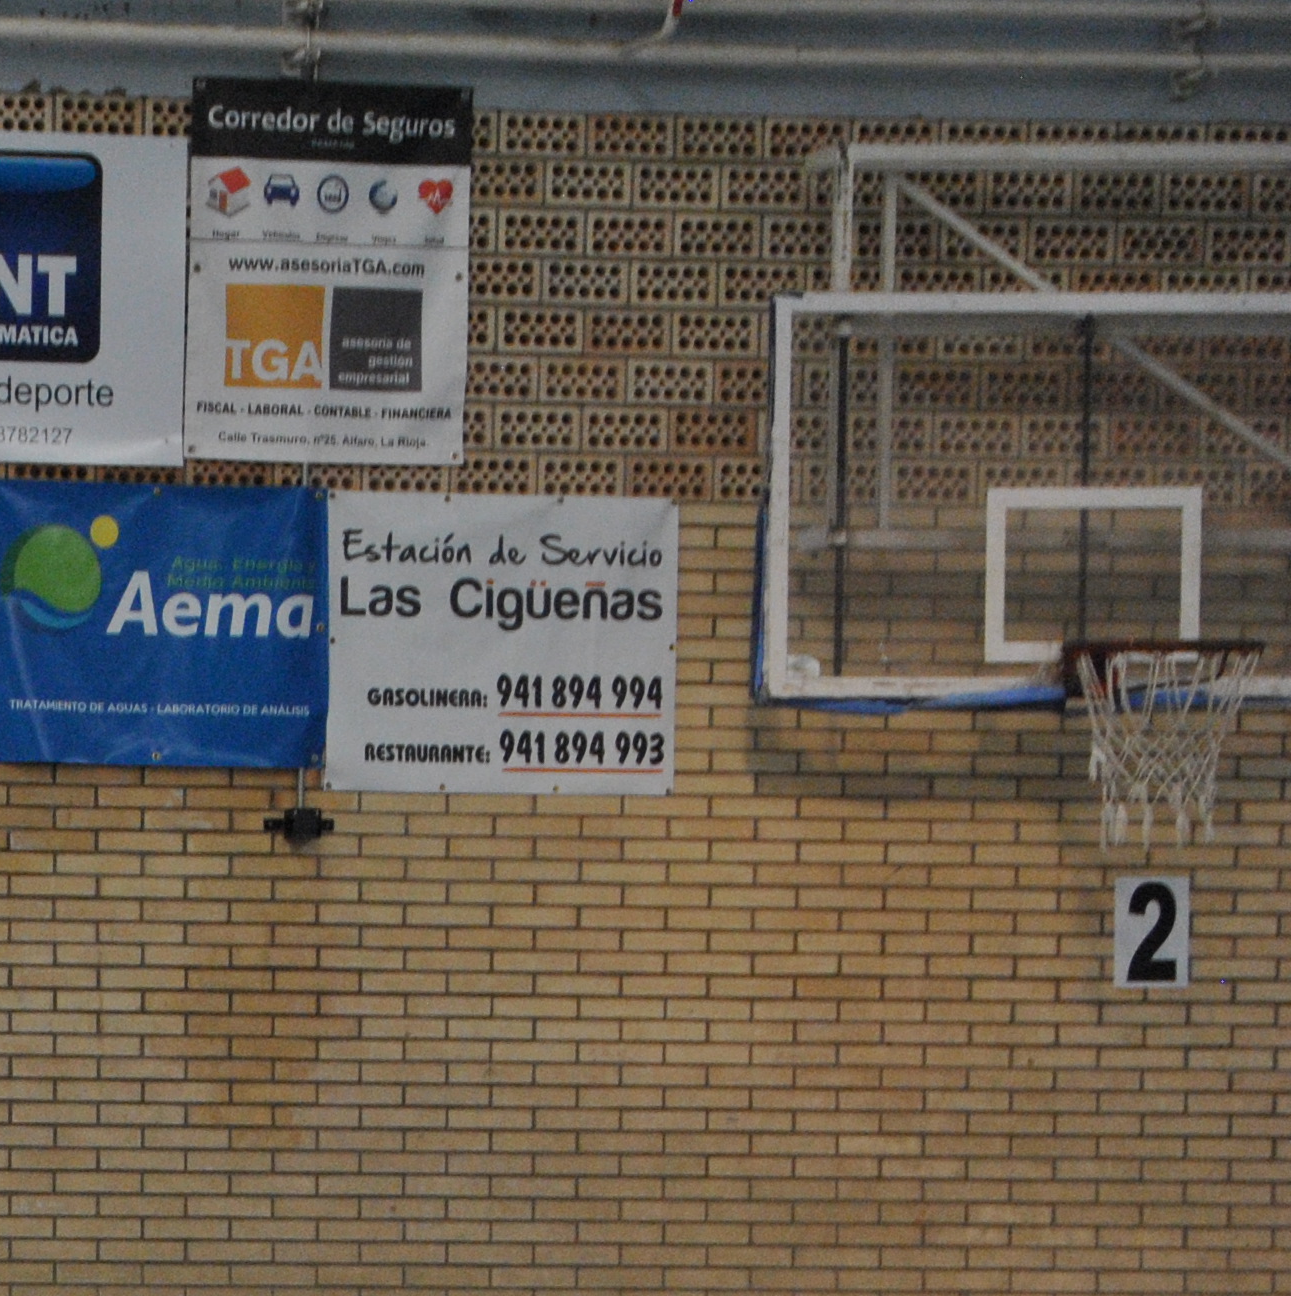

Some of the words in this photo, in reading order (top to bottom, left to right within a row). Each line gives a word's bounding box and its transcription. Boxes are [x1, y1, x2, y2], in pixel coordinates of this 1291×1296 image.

[208, 104, 321, 134] Corredor
[327, 108, 355, 136] de
[362, 110, 457, 145] Seguros
[228, 256, 427, 277] www.asesoriaTGA.com
[225, 337, 323, 383] TGA
[396, 337, 413, 351] de
[338, 370, 411, 386] empresarial
[196, 401, 238, 416] FISCAL
[248, 403, 304, 417] LABORAL
[314, 404, 372, 419] CONTABLE
[381, 407, 453, 421] FINANCIERA
[218, 430, 248, 444] Calle
[381, 437, 395, 449] La
[341, 528, 472, 565] Estación
[488, 534, 527, 567] de
[539, 532, 663, 567] Servicio
[106, 570, 315, 640] Aema
[340, 575, 421, 617] Las
[450, 576, 664, 631] Cigüeñas
[9, 698, 87, 713] TRATAMIENTO
[89, 700, 104, 713] DE
[107, 701, 148, 715] AGUAS
[157, 702, 241, 717] LABORATORIO
[242, 704, 258, 717] DE
[367, 687, 489, 709] GASOLINERA:
[496, 673, 543, 709] 941
[551, 674, 603, 710] 894
[611, 675, 663, 711] 994
[364, 742, 491, 765] RESTAURANTE:
[499, 729, 546, 765] 941
[554, 730, 605, 765] 894
[615, 731, 666, 766] 993
[1127, 882, 1178, 983] 2
